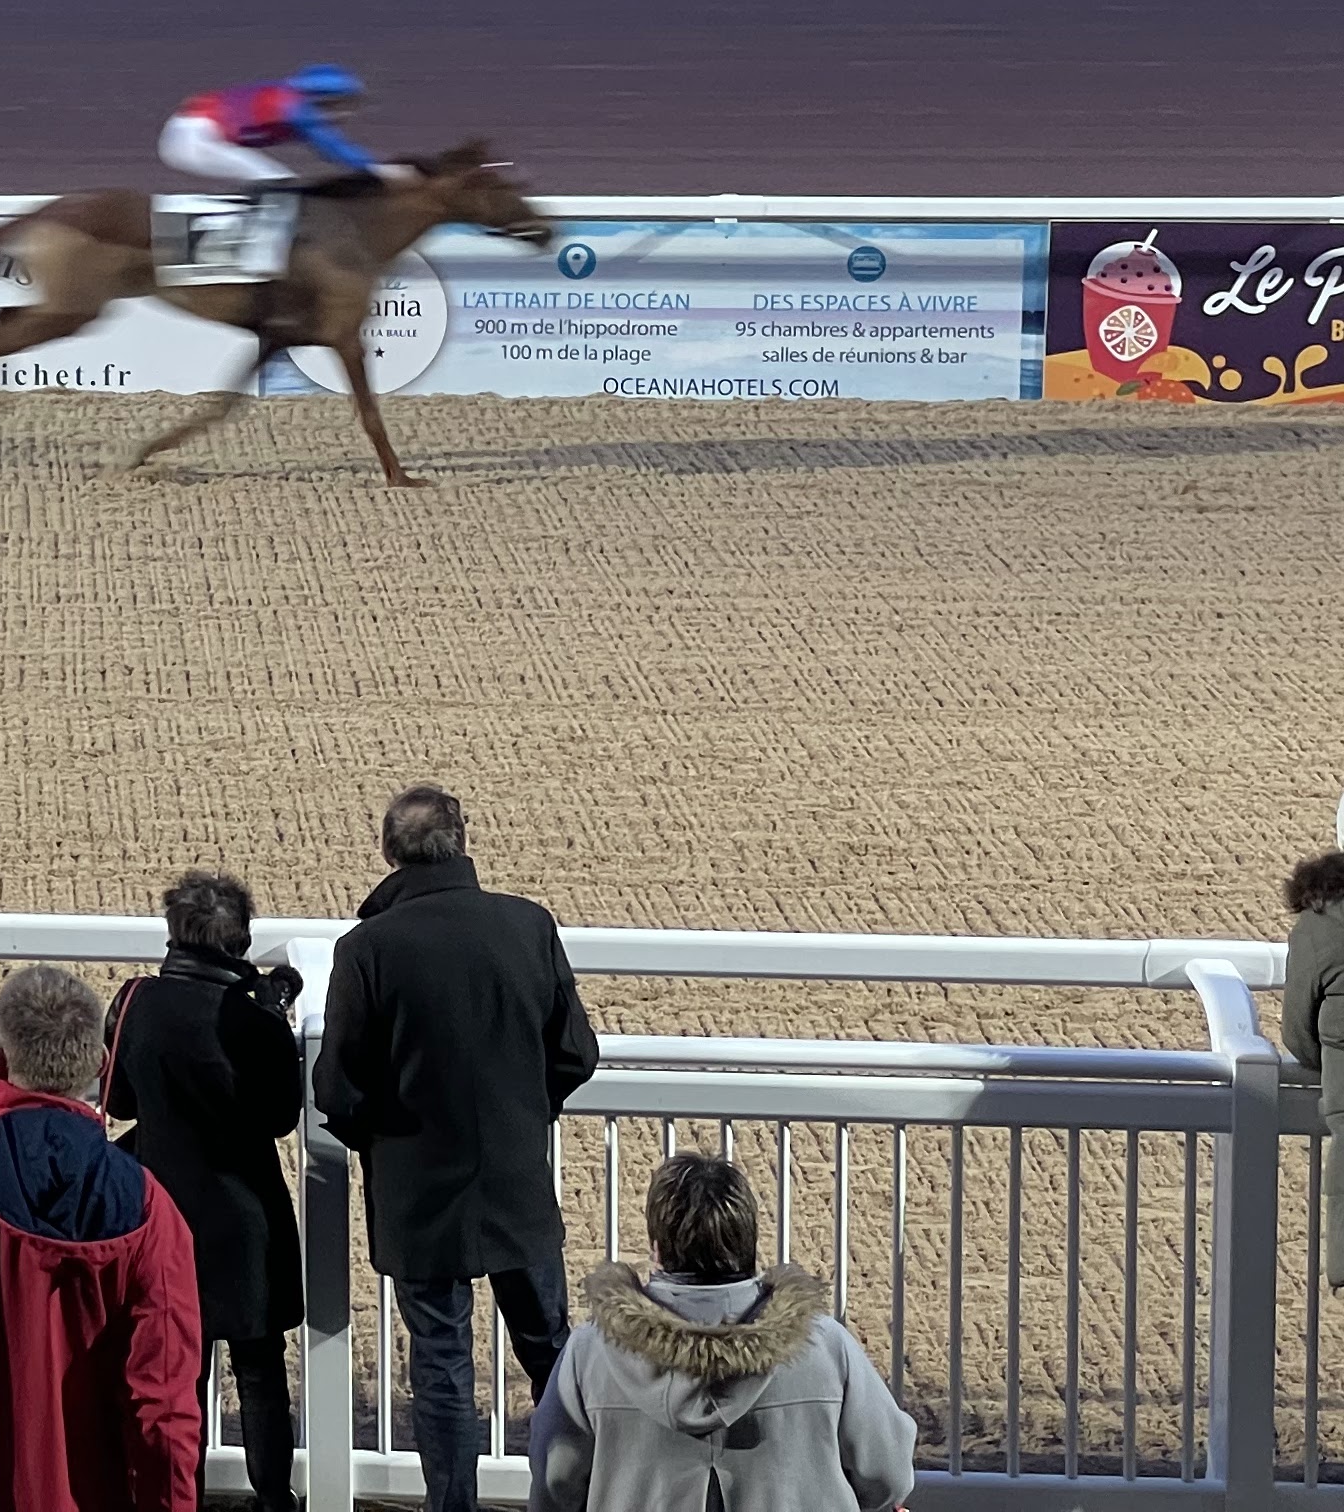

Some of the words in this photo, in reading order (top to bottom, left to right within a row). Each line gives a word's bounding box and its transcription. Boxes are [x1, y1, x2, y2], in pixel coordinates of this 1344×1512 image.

[1203, 244, 1294, 316] Le
[369, 293, 422, 317] ania
[463, 291, 561, 309] L'ATTRAIT
[567, 292, 594, 309] DE
[601, 290, 690, 311] L'OCÉAN
[753, 293, 794, 311] DES
[801, 294, 891, 312] ESPACES
[897, 291, 912, 312] À
[917, 295, 978, 313] VIVRE
[387, 329, 417, 338] BAULE
[475, 319, 506, 335] 900
[511, 322, 528, 335] m
[532, 318, 554, 335] de
[559, 318, 678, 339] l'hippodrome
[735, 321, 756, 337] 95
[761, 321, 848, 338] chambres
[854, 322, 866, 337] &
[869, 324, 995, 342] appartements
[501, 344, 531, 360] 100
[536, 348, 552, 360] m
[557, 344, 579, 360] de
[584, 345, 597, 361] la
[603, 345, 652, 365] plage
[762, 346, 808, 363] salles
[813, 347, 835, 363] de
[839, 347, 916, 363] réunions
[920, 349, 934, 363] &
[938, 348, 967, 364] bar
[602, 377, 839, 396] OCEANIAHOTELS.COM
